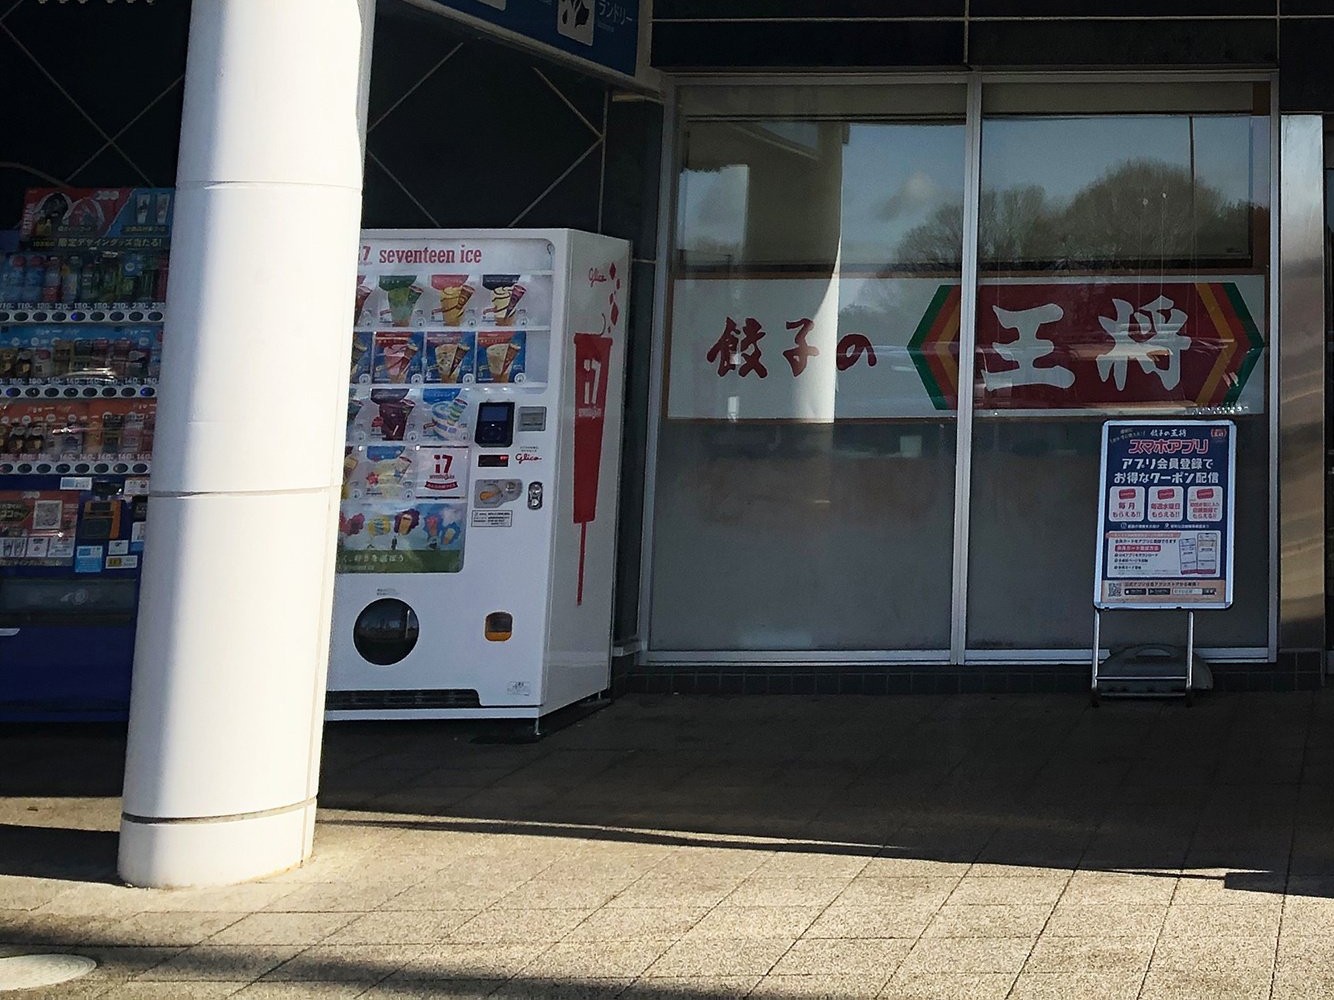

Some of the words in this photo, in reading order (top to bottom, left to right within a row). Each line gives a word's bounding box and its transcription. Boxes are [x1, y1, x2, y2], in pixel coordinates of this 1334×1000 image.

[379, 247, 455, 263] seventeen
[460, 244, 482, 263] ice
[706, 315, 878, 379] 餃子の
[984, 295, 1192, 392] 王将
[1128, 439, 1209, 455] スマホアプリ
[515, 453, 543, 465] Glico
[1122, 458, 1213, 469] アプリ会員登録で
[1114, 472, 1219, 484] お得なクーポン配信
